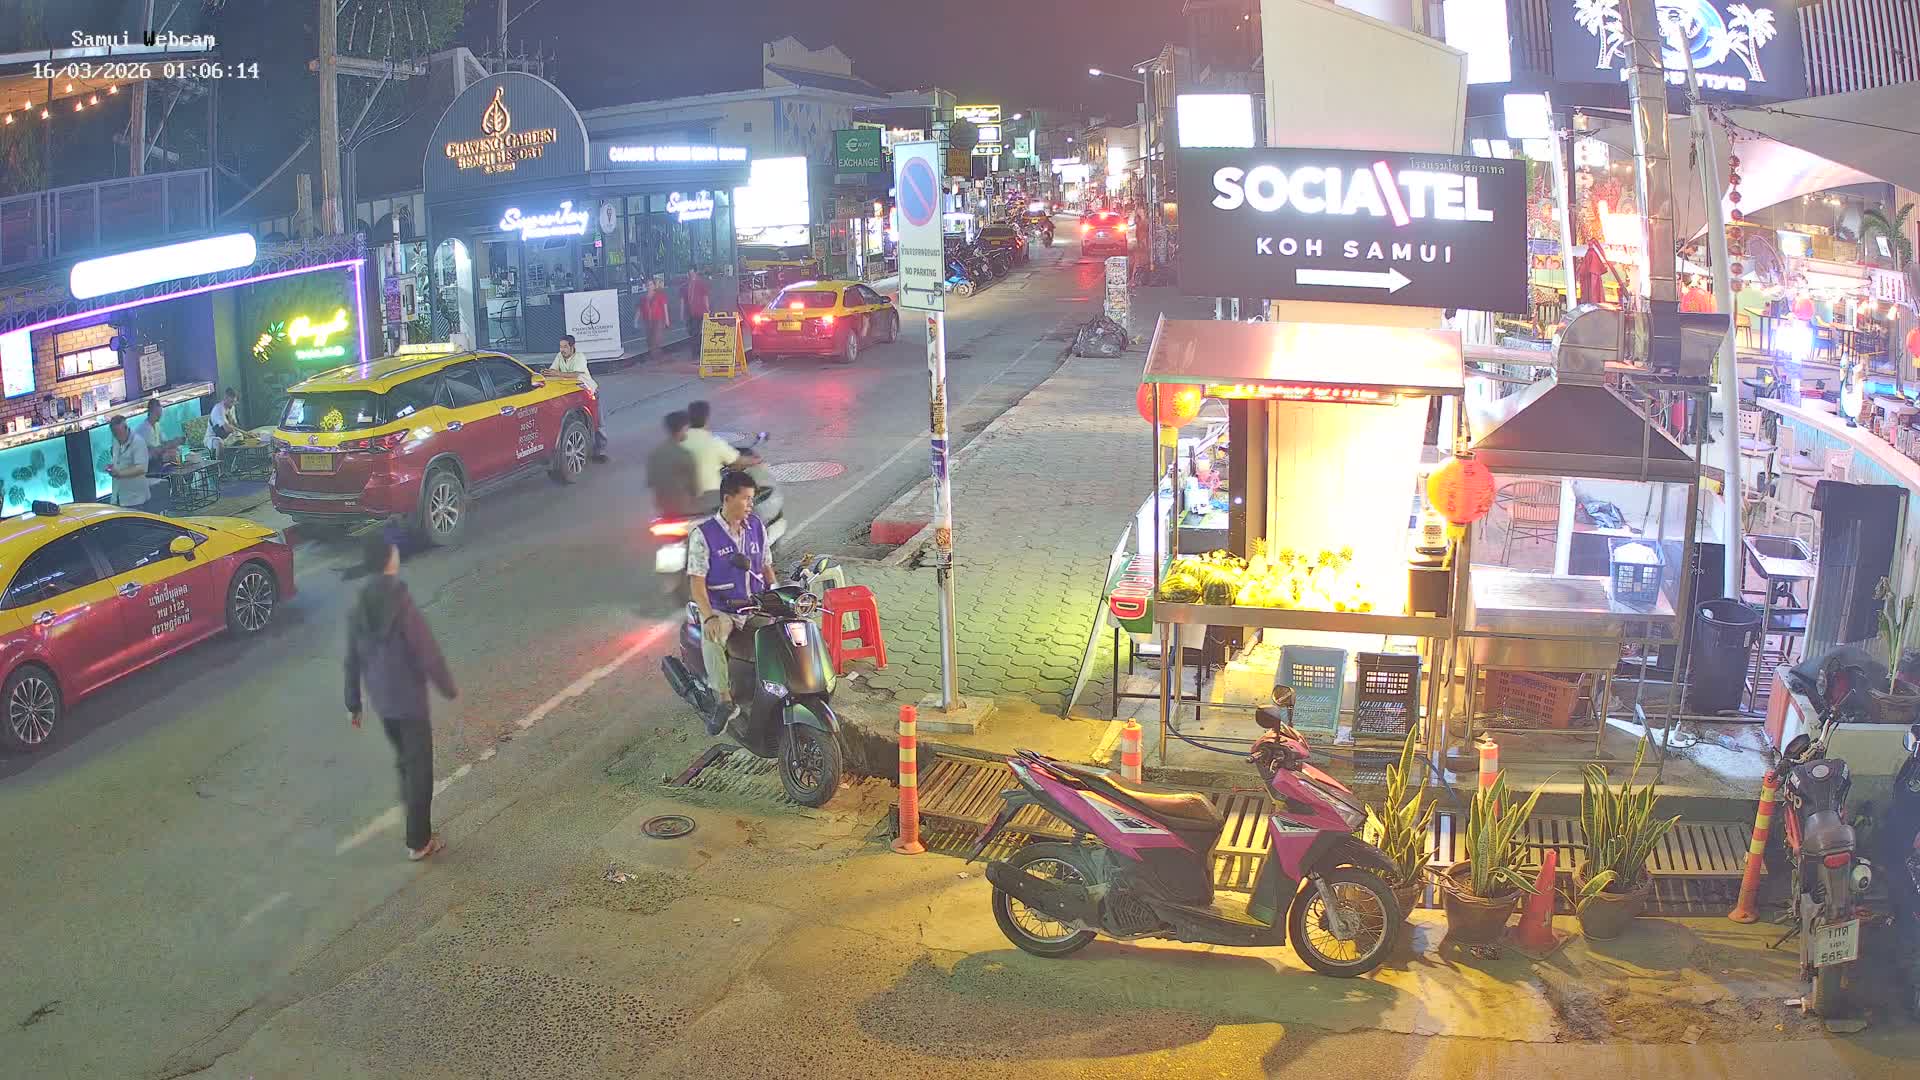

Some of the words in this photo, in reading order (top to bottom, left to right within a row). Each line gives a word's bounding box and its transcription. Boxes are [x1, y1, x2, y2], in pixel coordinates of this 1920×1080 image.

[838, 157, 879, 168] EXCHANGE
[1256, 237, 1323, 257] KOH
[1343, 240, 1451, 263] SAMUI
[905, 266, 913, 276] NO
[914, 267, 937, 278] PARKING
[718, 545, 734, 557] TAXI
[750, 541, 760, 554] 21
[1108, 573, 1155, 621] FOOD
[169, 600, 185, 614] 1123
